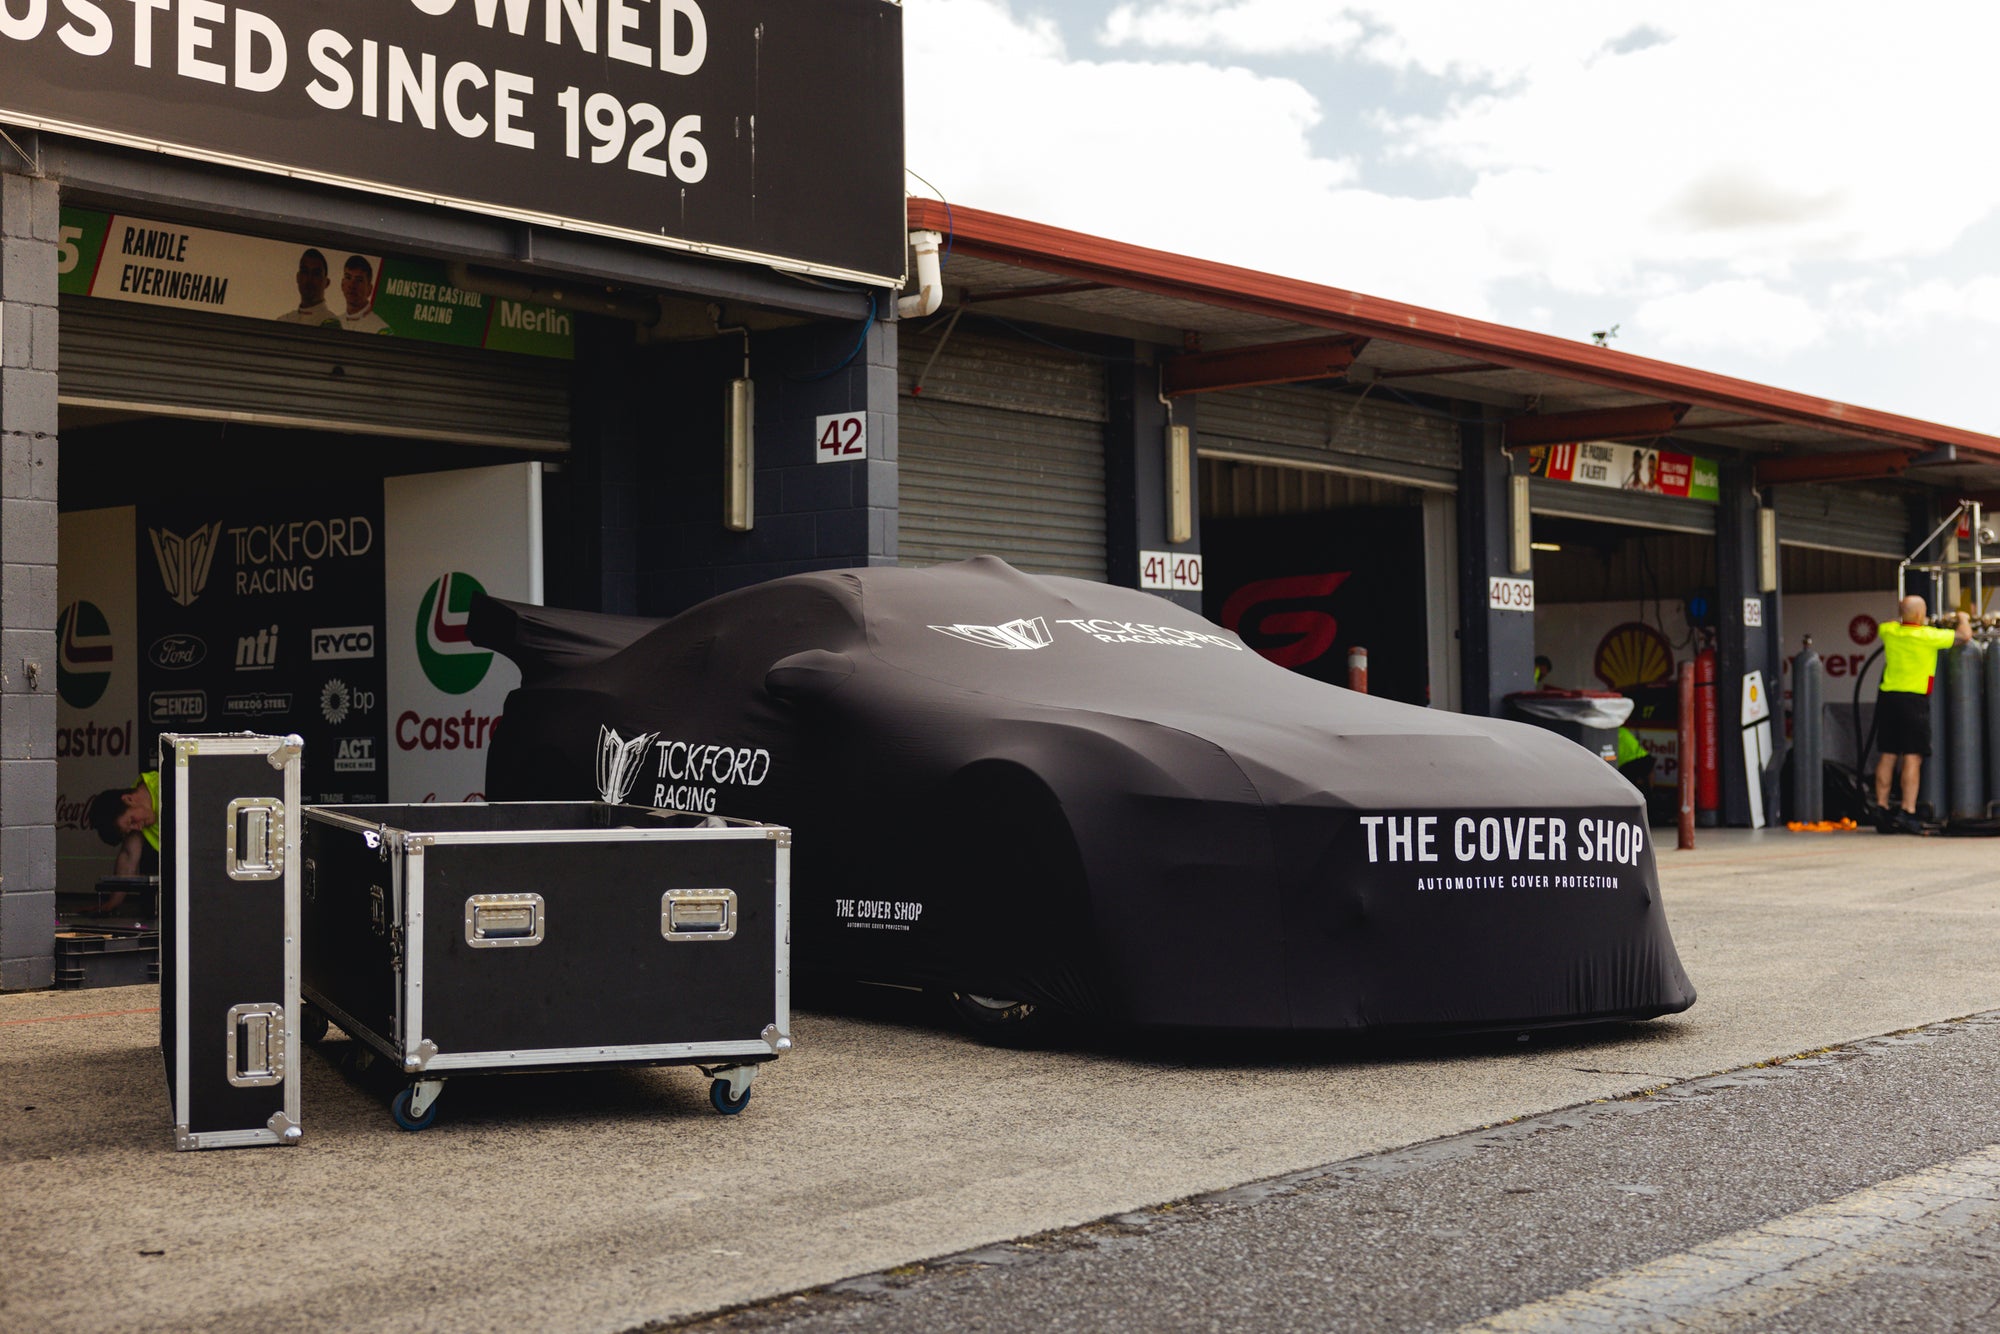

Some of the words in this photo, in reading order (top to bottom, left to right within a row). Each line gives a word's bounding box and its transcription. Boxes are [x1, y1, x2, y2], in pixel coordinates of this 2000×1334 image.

[408, 0, 708, 76] NED
[305, 29, 535, 149] SINCE
[558, 86, 708, 183] 1926
[122, 227, 189, 262] RANDLE
[120, 264, 228, 305] EVERINGHAM
[386, 278, 436, 301] MONSTER
[438, 286, 482, 308] CASTROL
[413, 304, 453, 325] RACING
[501, 300, 570, 336] Merlin
[820, 418, 862, 456] 42
[227, 516, 373, 565] TICKFORD
[236, 566, 314, 595] RACING
[1144, 556, 1165, 584] 41
[1174, 559, 1199, 585] 40
[1491, 582, 1510, 605] 40
[1513, 584, 1531, 606] 39
[235, 624, 279, 666] nti
[314, 632, 372, 654] RYCO
[1056, 619, 1243, 651] TICKFORD
[1093, 633, 1203, 648] RACING
[159, 638, 196, 664] Ford
[168, 697, 203, 715] ENZED
[228, 699, 262, 710] HERZOG
[263, 698, 287, 709] STEEL
[353, 687, 375, 714] bp
[56, 719, 132, 758] astrol
[338, 739, 372, 759] ACT
[655, 740, 770, 786] TICKFORD
[653, 783, 716, 813] RACING
[1360, 816, 1439, 863] THE
[1454, 816, 1567, 862] COVER
[1577, 818, 1643, 867] SHOP
[1417, 876, 1504, 891] AUTOMOTIVE
[1511, 876, 1549, 889] COVER
[1555, 876, 1618, 889] PROTECTION
[836, 899, 855, 917] THE
[857, 899, 892, 919] COVER
[894, 901, 923, 921] SHOP
